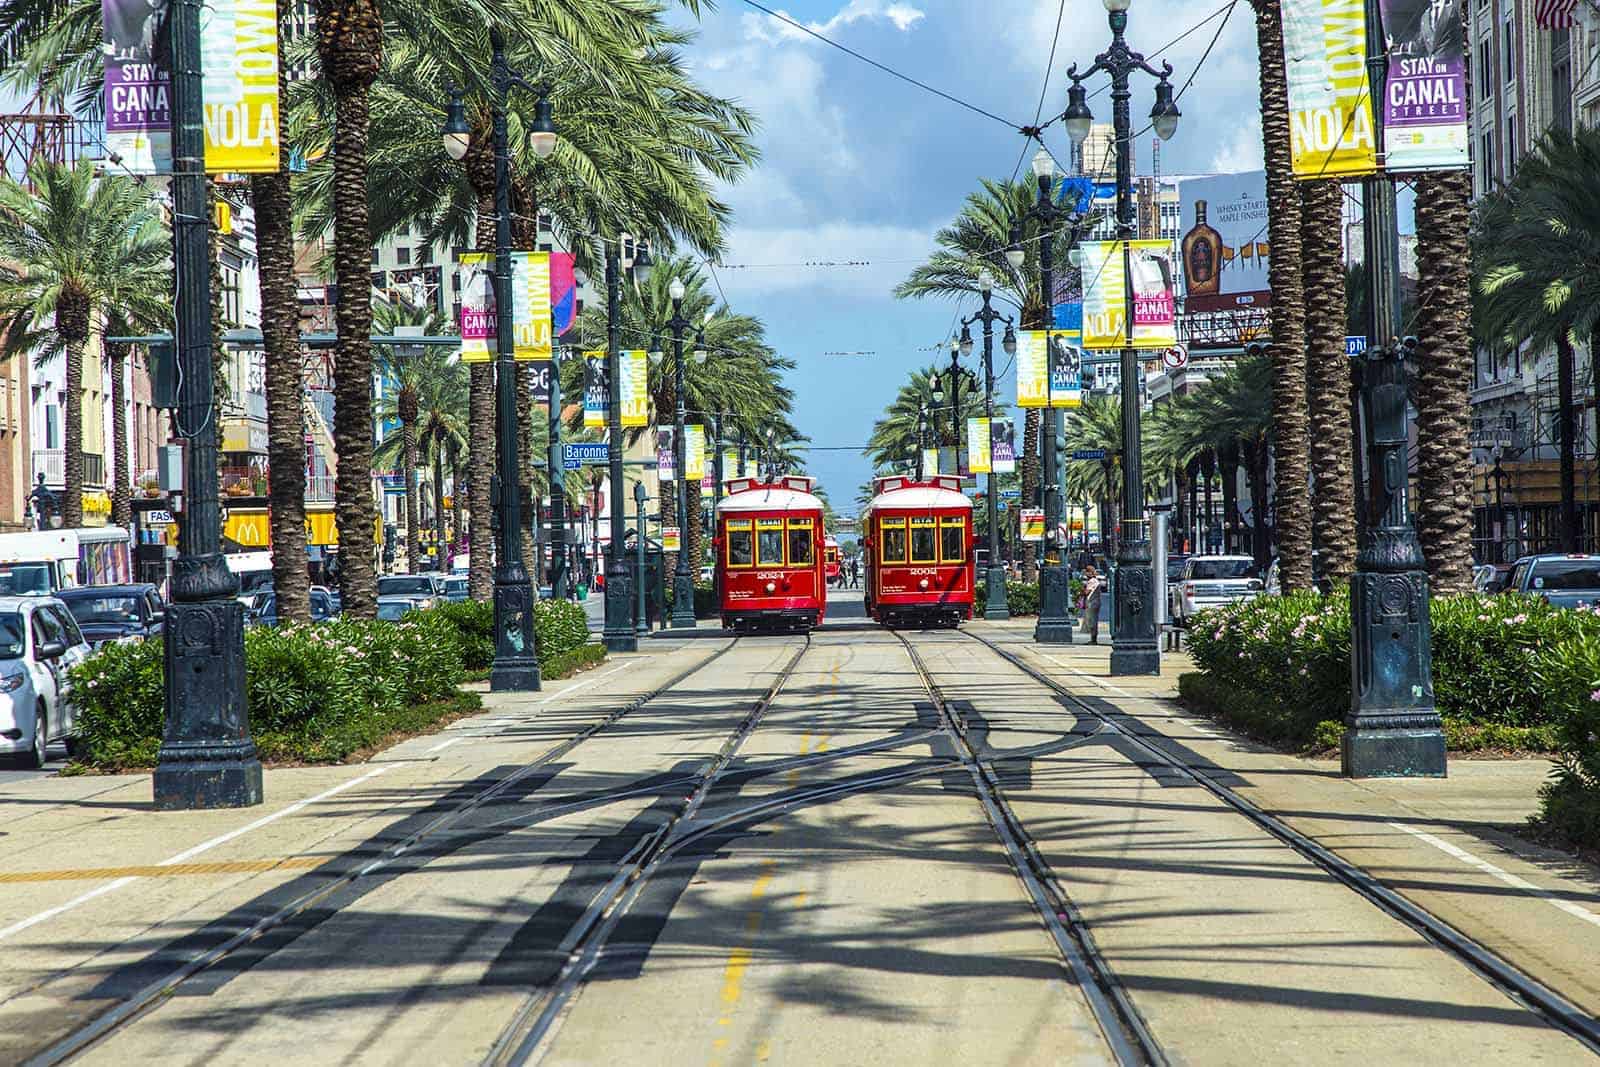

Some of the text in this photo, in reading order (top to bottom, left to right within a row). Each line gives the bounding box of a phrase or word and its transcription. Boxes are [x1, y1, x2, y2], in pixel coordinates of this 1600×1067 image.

[122, 64, 155, 81] STAY
[1400, 58, 1447, 76] STAY ON
[112, 86, 169, 112] CANA
[1390, 78, 1460, 107] CANAL
[114, 112, 169, 122] STREE
[1391, 104, 1461, 118] STREET
[205, 103, 278, 148] NOLA
[1293, 103, 1375, 153] NOLA
[1135, 300, 1169, 315] CANAL
[1086, 312, 1124, 337] NOLA
[1053, 372, 1079, 385] CANAL
[566, 445, 608, 457] Baronne
